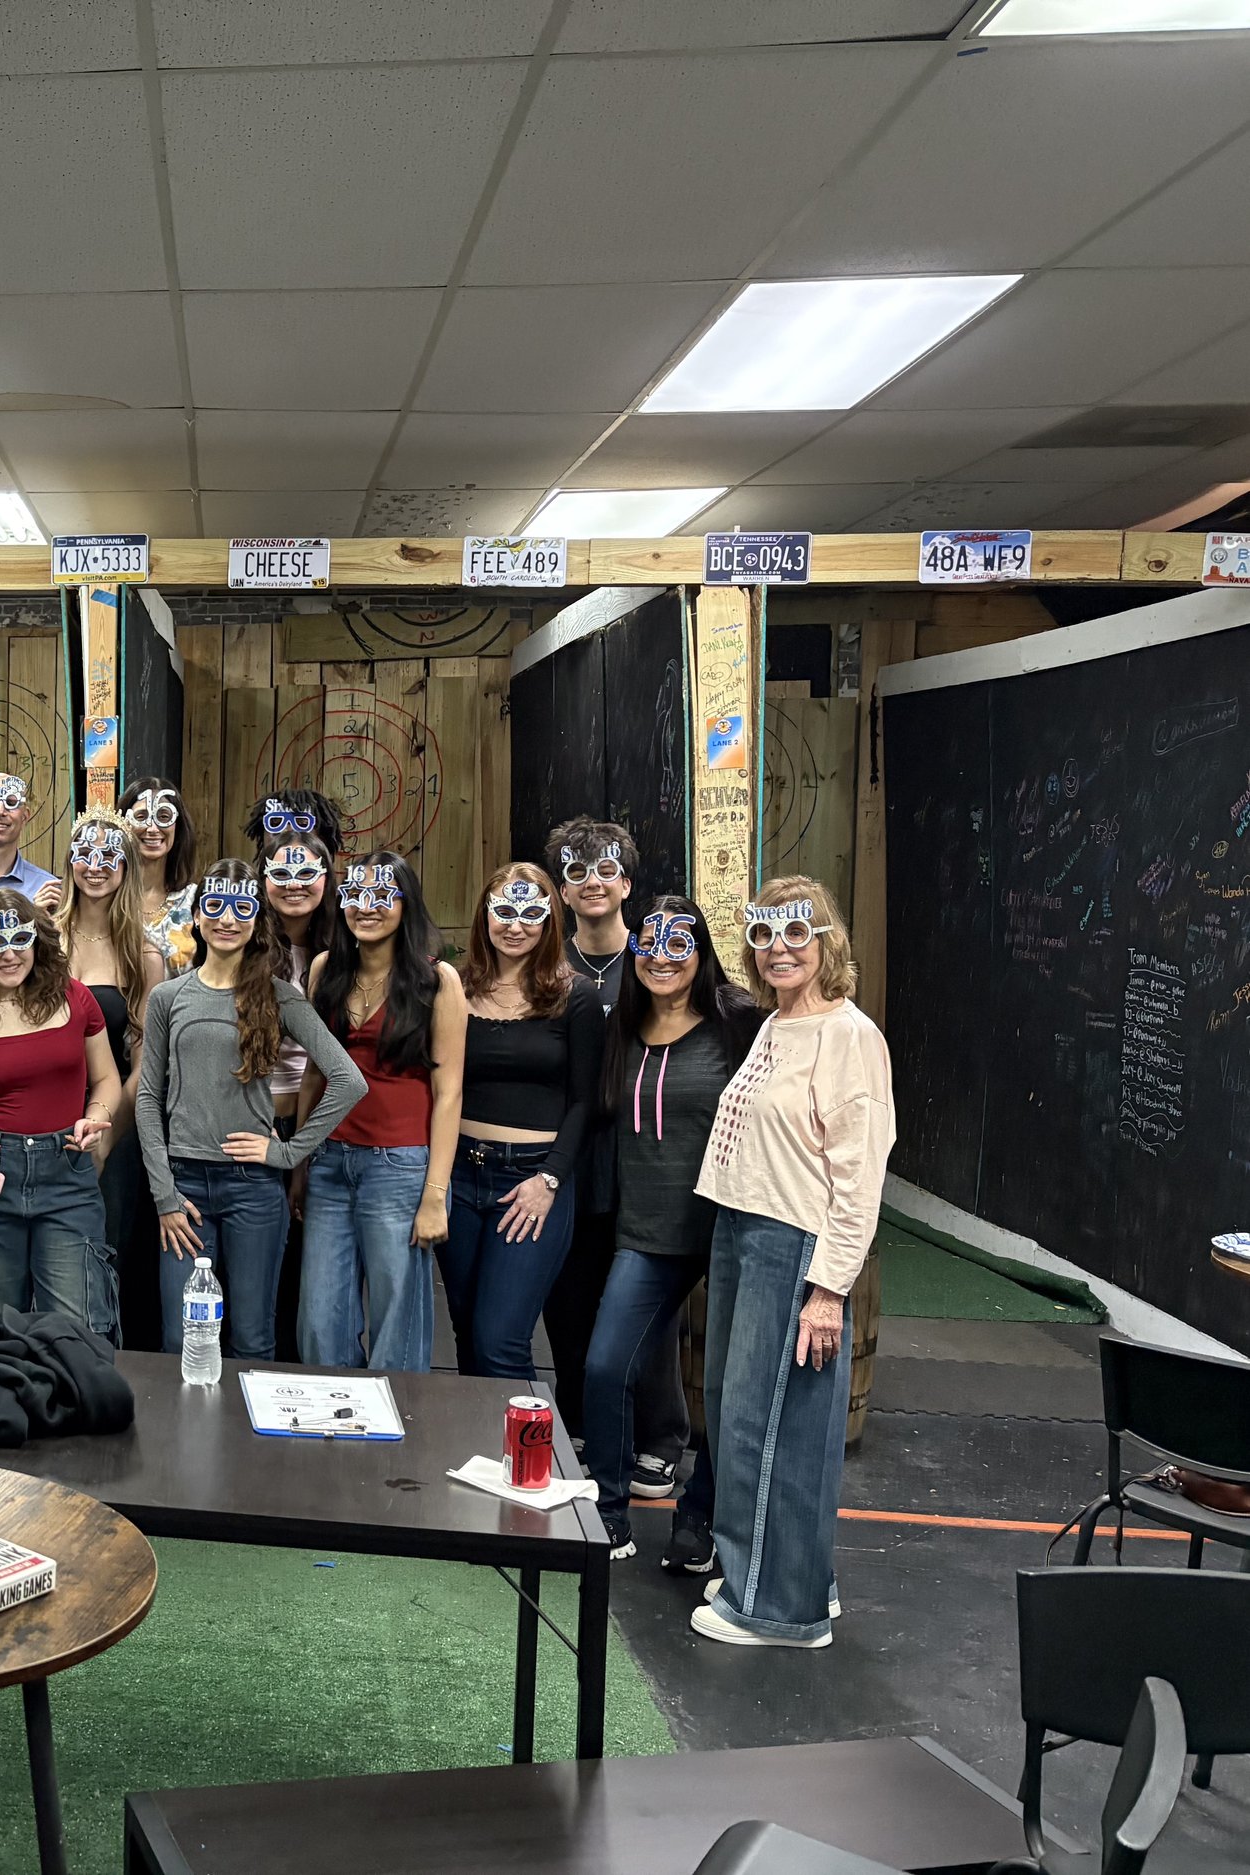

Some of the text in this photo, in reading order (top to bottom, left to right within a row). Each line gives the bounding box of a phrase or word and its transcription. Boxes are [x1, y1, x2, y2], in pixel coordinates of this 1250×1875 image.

[76, 538, 125, 546] PENNSYLVANIA
[232, 539, 287, 548] WISCONSIN
[59, 547, 141, 573] KJX 5333
[244, 551, 314, 578] CHEESE
[470, 551, 559, 574] FEE 489
[709, 545, 806, 571] BCE 0943
[925, 544, 1026, 572] 48A WF9
[230, 578, 244, 588] JAN
[342, 773, 360, 799] 5
[382, 774, 397, 794] 3
[404, 776, 423, 797] 2
[427, 773, 442, 797] 1
[136, 789, 179, 829] 16
[283, 846, 306, 865] 16
[345, 864, 394, 883] 16 16
[643, 912, 696, 962] 16
[23, 1570, 54, 1598] GAMES
